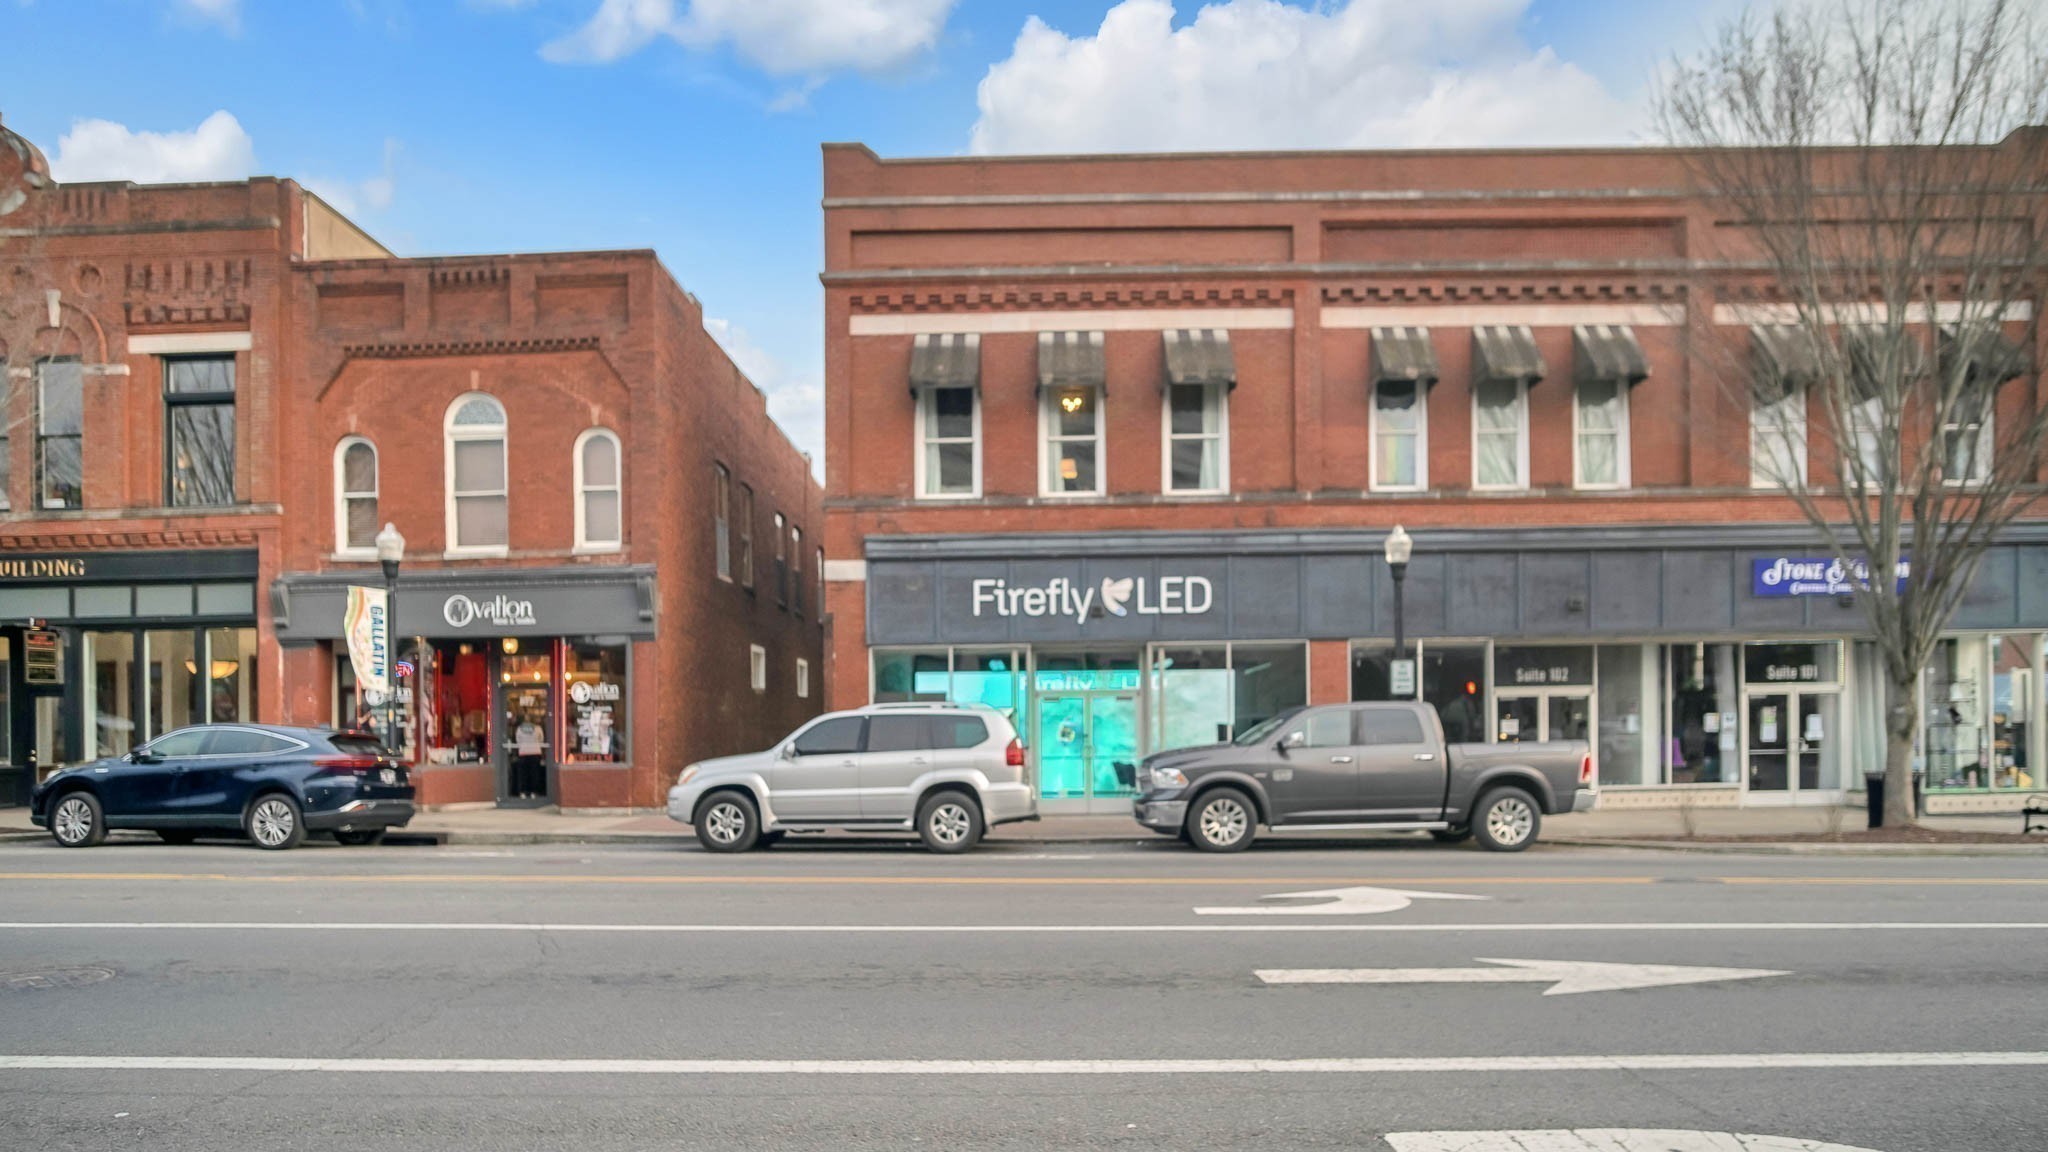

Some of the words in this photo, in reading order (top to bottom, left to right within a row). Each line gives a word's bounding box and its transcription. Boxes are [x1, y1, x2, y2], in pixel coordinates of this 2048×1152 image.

[972, 577, 1095, 625] Firefly
[1136, 576, 1213, 615] LED
[371, 606, 385, 677] GALLATIN
[1515, 666, 1546, 683] Suite
[1549, 666, 1569, 682] 102
[1765, 664, 1798, 680] Suite
